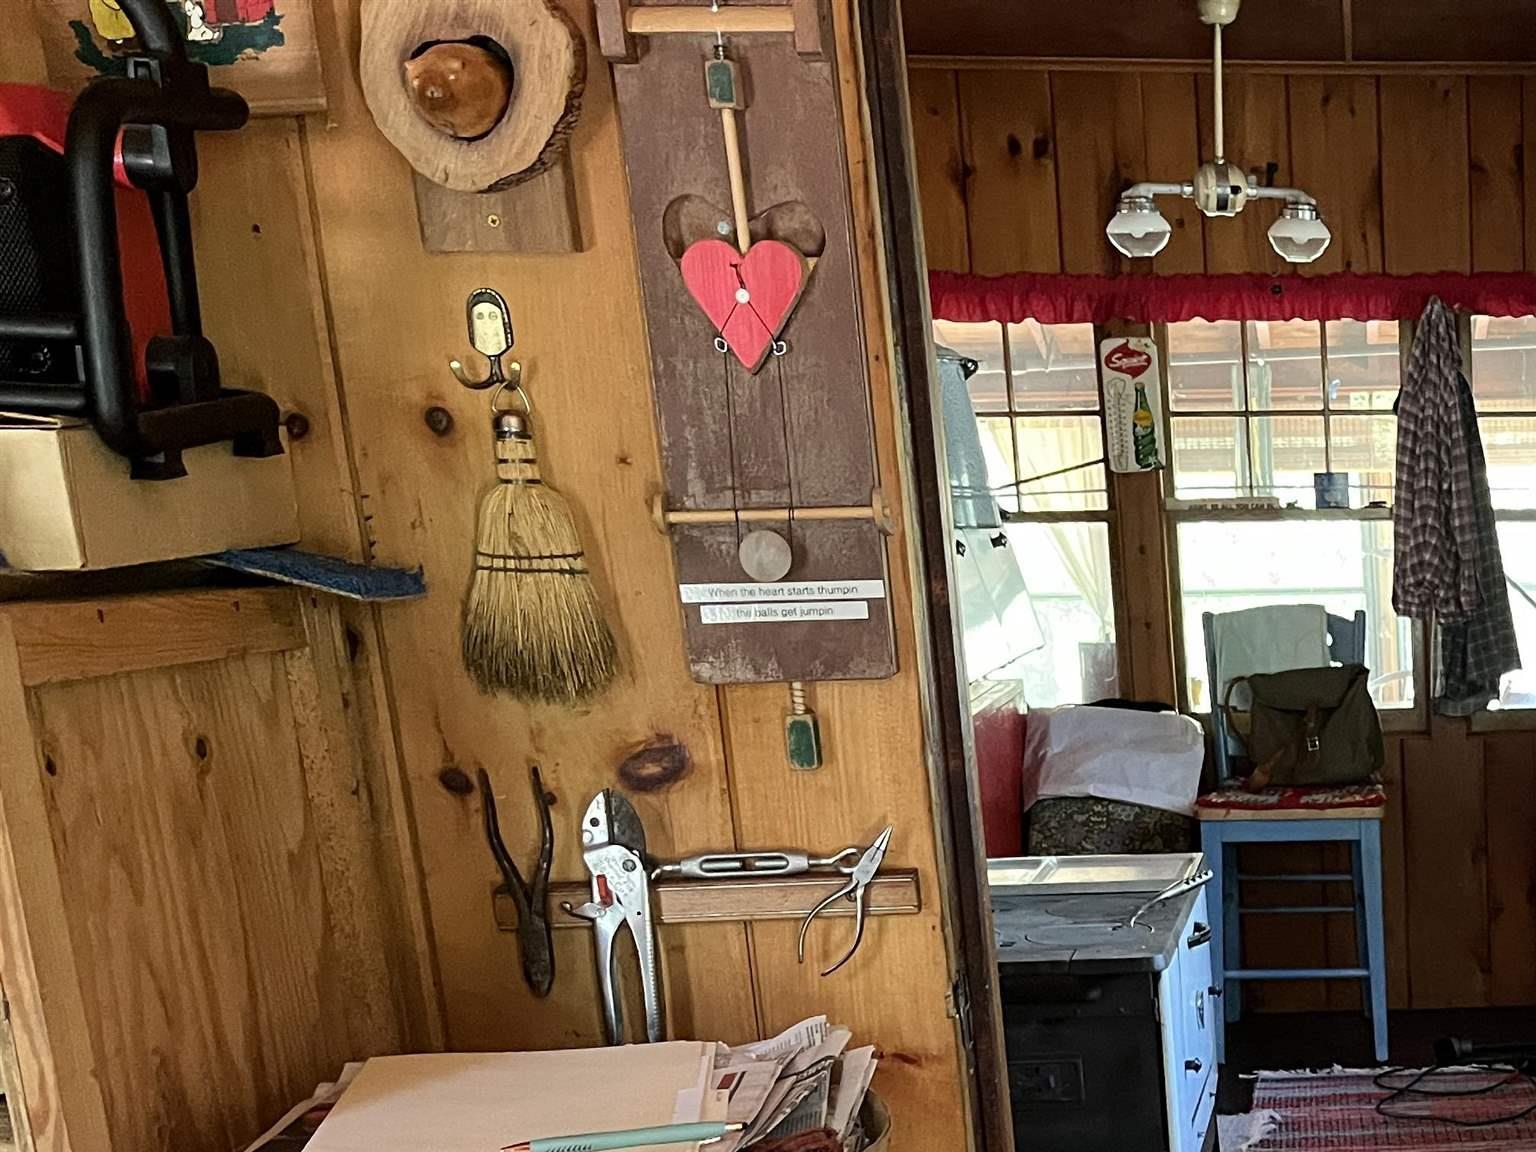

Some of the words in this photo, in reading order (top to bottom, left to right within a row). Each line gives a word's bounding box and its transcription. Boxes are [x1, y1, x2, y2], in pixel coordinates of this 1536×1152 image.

[708, 587, 738, 597] When
[739, 586, 756, 597] the
[758, 585, 785, 596] heart
[787, 586, 815, 596] starts
[817, 585, 858, 597] thumpin
[754, 607, 779, 617] balls
[781, 608, 798, 618] get
[799, 606, 834, 618] jumpin
